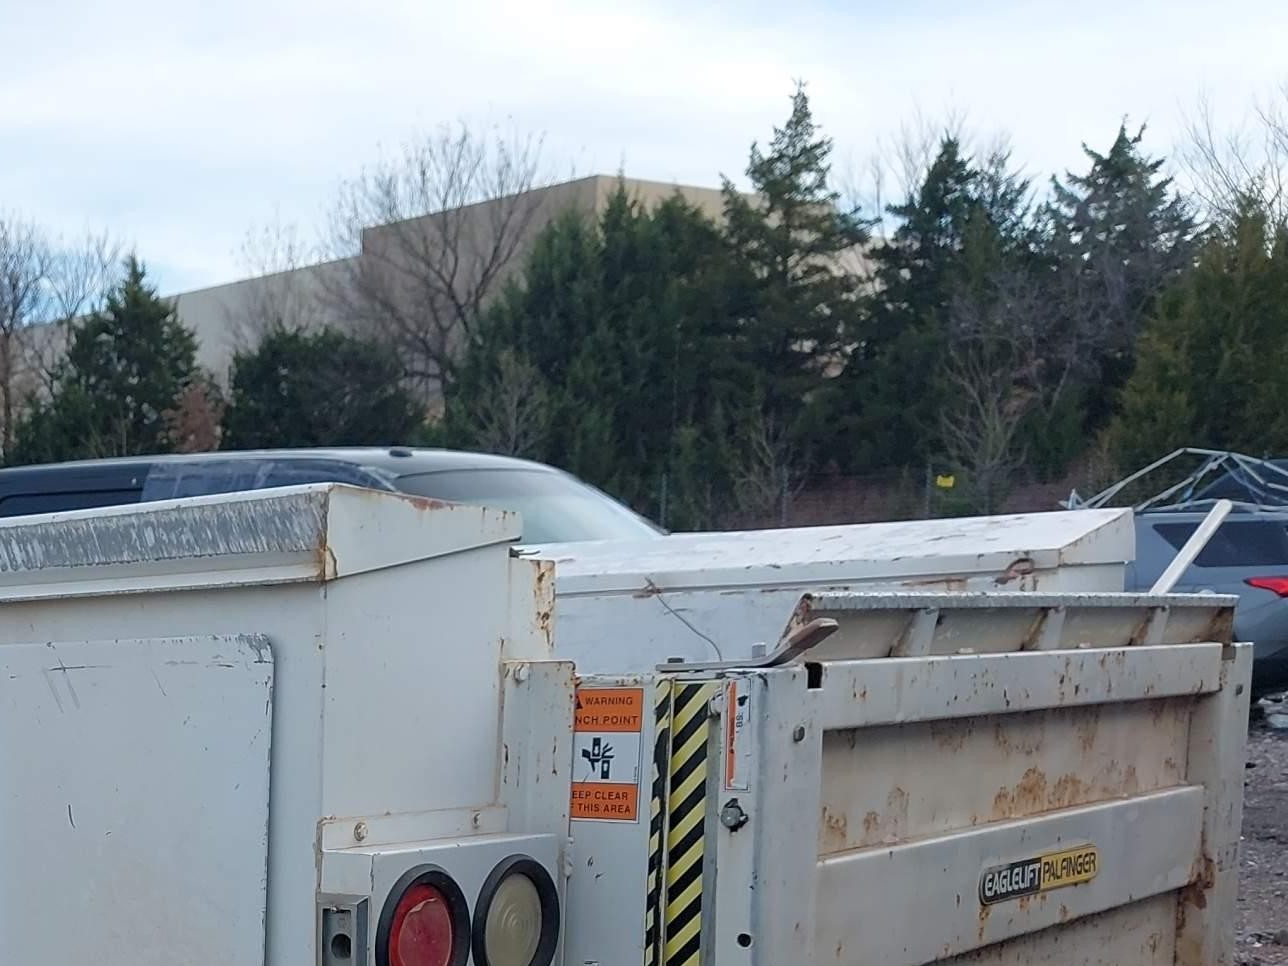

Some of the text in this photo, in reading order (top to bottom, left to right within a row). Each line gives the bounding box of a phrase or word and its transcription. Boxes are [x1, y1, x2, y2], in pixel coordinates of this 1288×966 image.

[584, 696, 633, 706] WARNING
[575, 715, 640, 726] NCH POINT
[571, 790, 629, 801] EEP CLEAR
[577, 802, 600, 812] THIS
[603, 803, 631, 814] AREA
[984, 851, 1097, 898] EAGLELIFT PALFINGER
